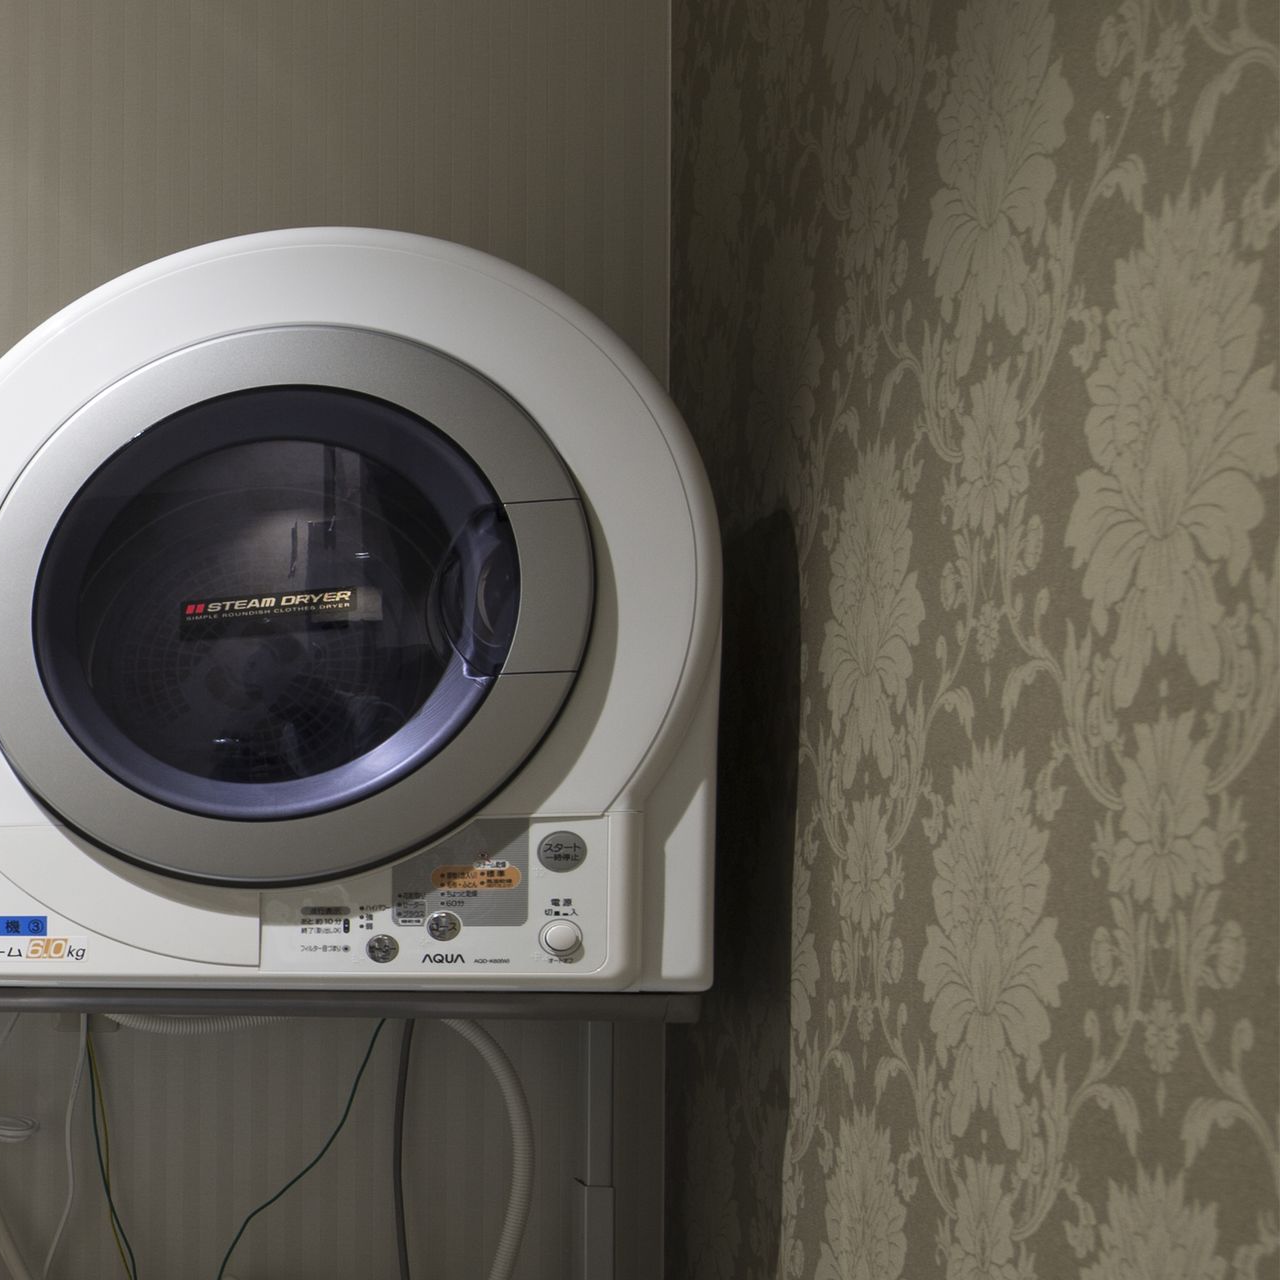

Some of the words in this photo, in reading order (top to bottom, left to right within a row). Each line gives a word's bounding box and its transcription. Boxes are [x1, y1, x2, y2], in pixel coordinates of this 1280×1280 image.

[207, 597, 275, 612] STEAM
[281, 590, 352, 606] DRYER
[222, 609, 271, 618] ROUNDISH
[274, 606, 316, 614] CLOTHES
[319, 602, 350, 610] DRYER
[544, 843, 582, 853] スタート
[545, 853, 580, 862] 一時停止
[551, 898, 572, 907] 電源
[422, 953, 465, 964] AQUA
